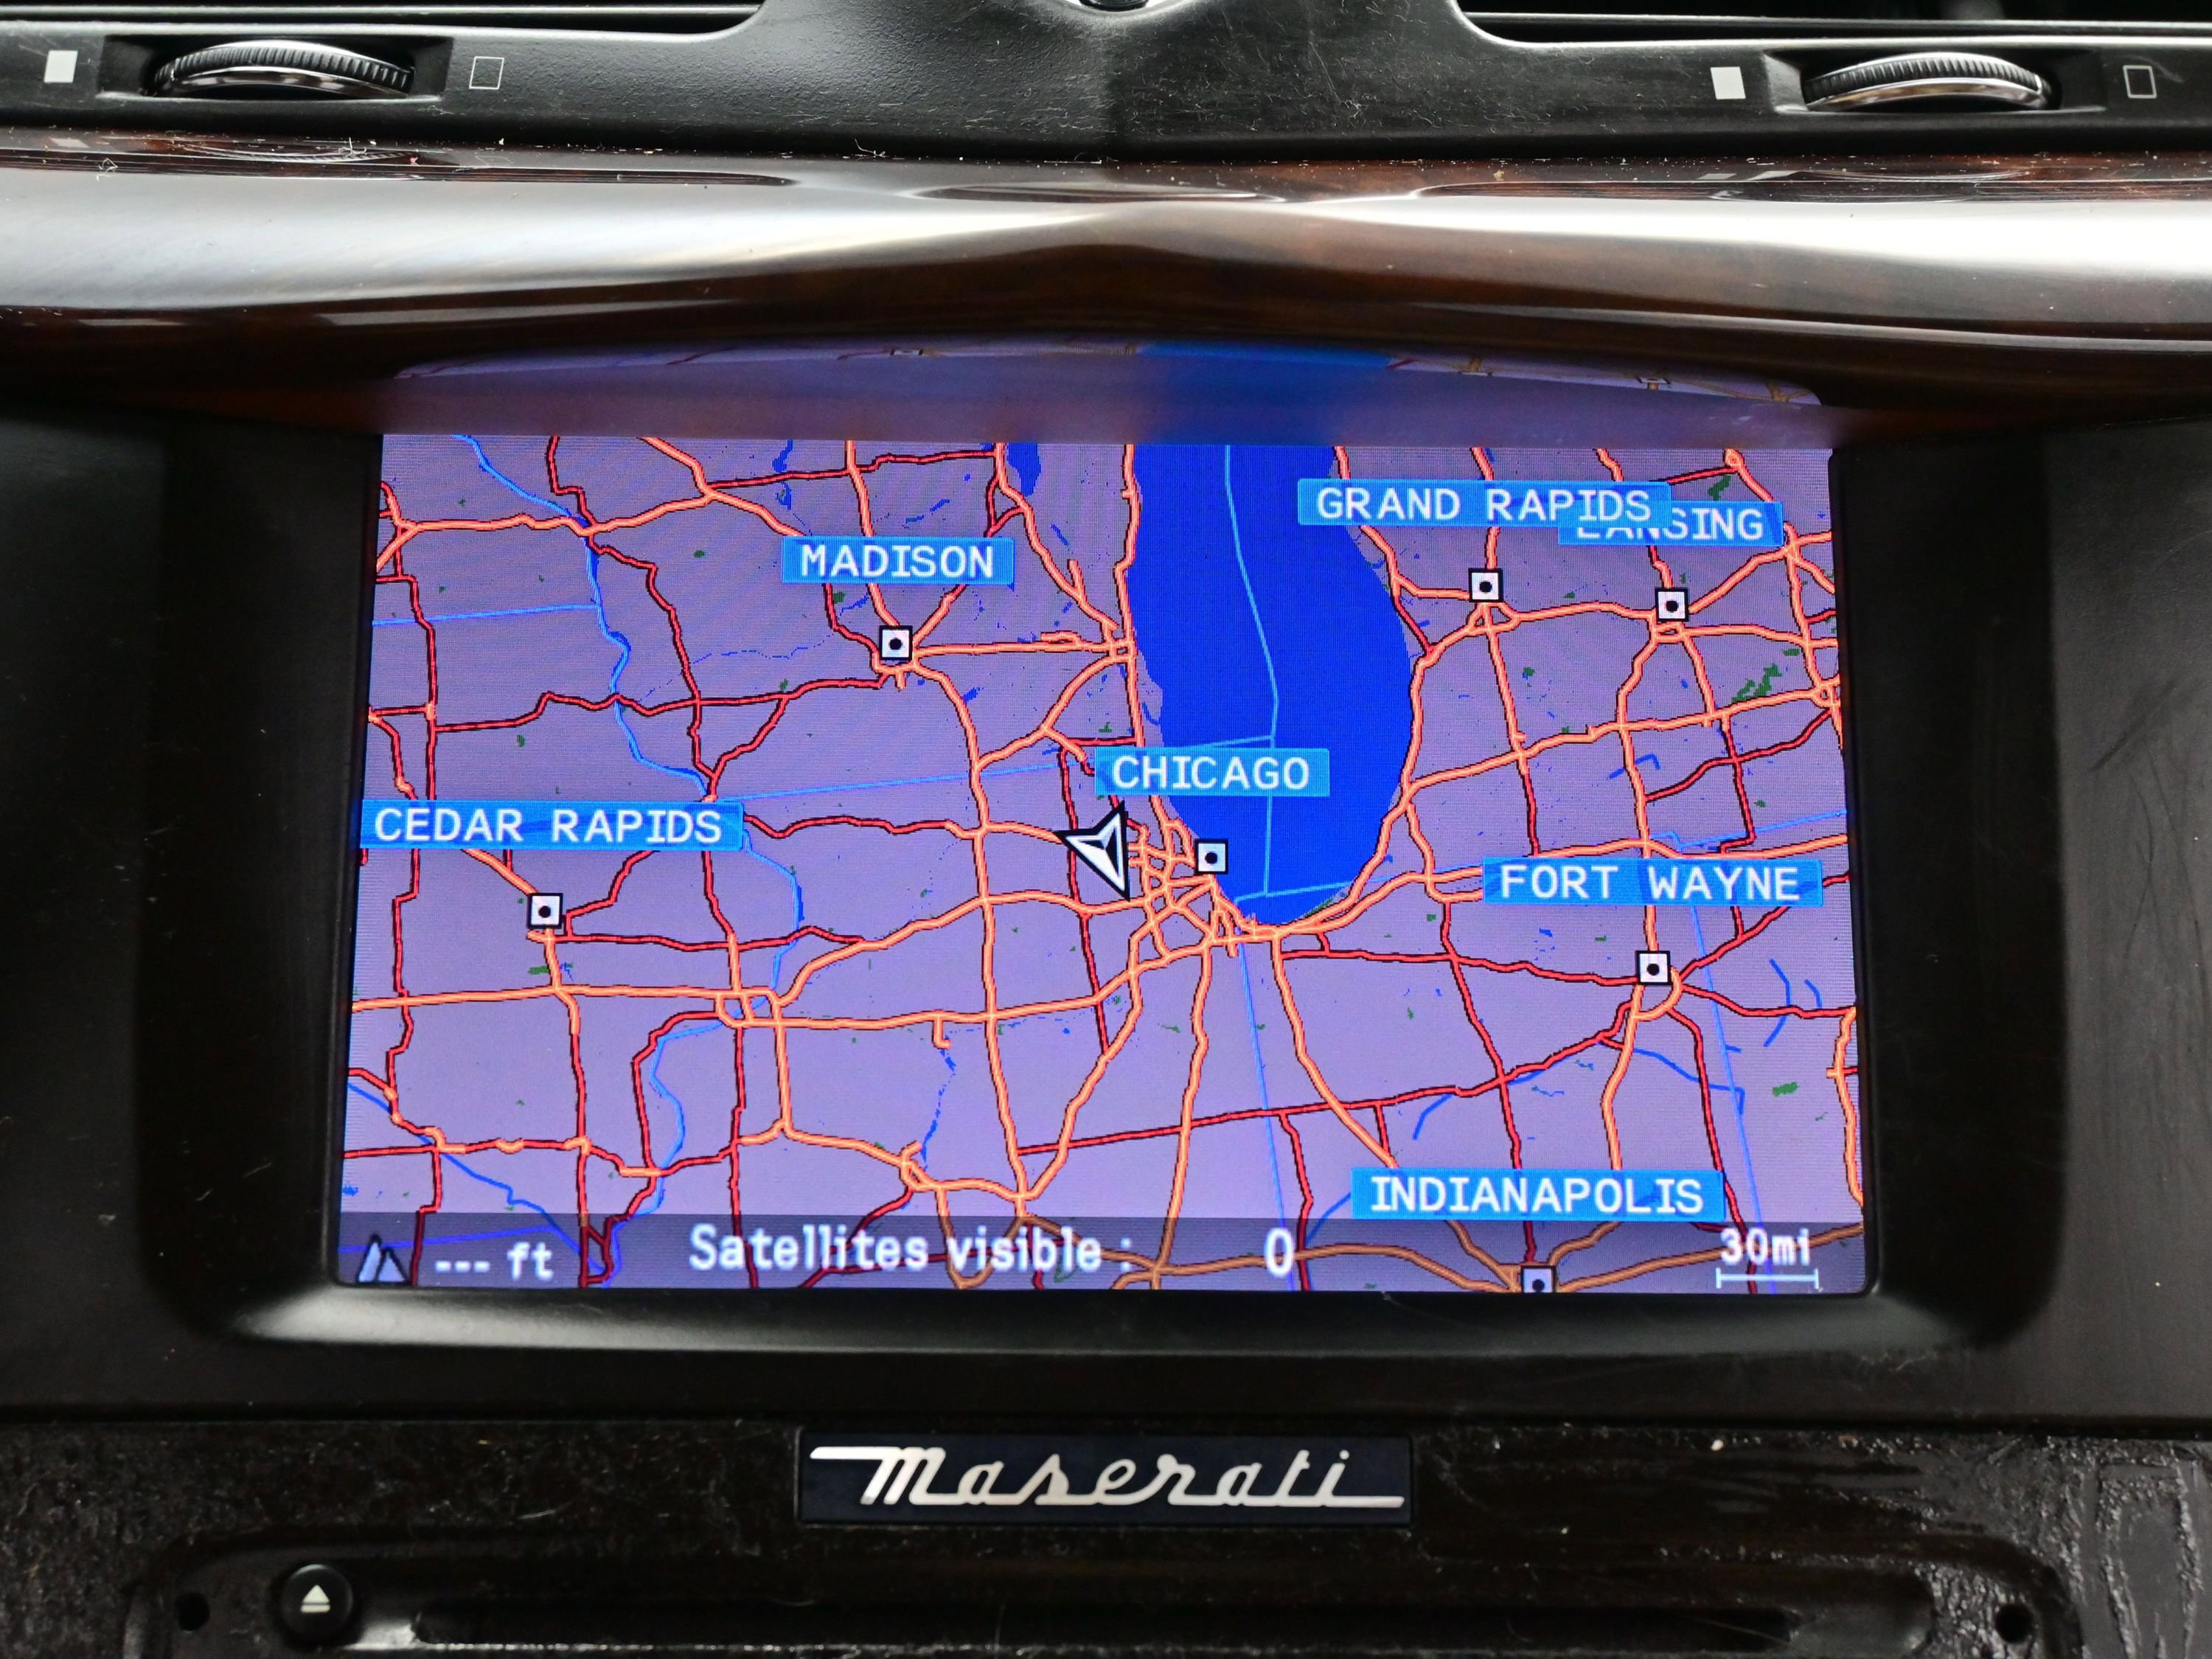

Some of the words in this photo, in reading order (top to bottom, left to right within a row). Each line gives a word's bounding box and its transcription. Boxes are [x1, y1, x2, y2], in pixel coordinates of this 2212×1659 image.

[1318, 487, 1460, 521] GRAND
[1487, 489, 1652, 522] RAPIDS
[801, 544, 993, 578] MADISON
[1113, 755, 1310, 790] CHICAGO
[375, 808, 523, 842] CEDAR
[553, 809, 722, 843] RAPIDS
[1501, 864, 1618, 899] FORT
[1649, 864, 1800, 901] WAYNE
[1371, 1176, 1704, 1214] INDIANAPOLIS
[507, 1242, 554, 1280] ft
[689, 1224, 929, 1271] Satellites
[946, 1225, 1102, 1273] visible
[1264, 1228, 1294, 1277] 0
[1720, 1228, 1810, 1266] 30mi
[810, 1446, 1405, 1509] Maserati
